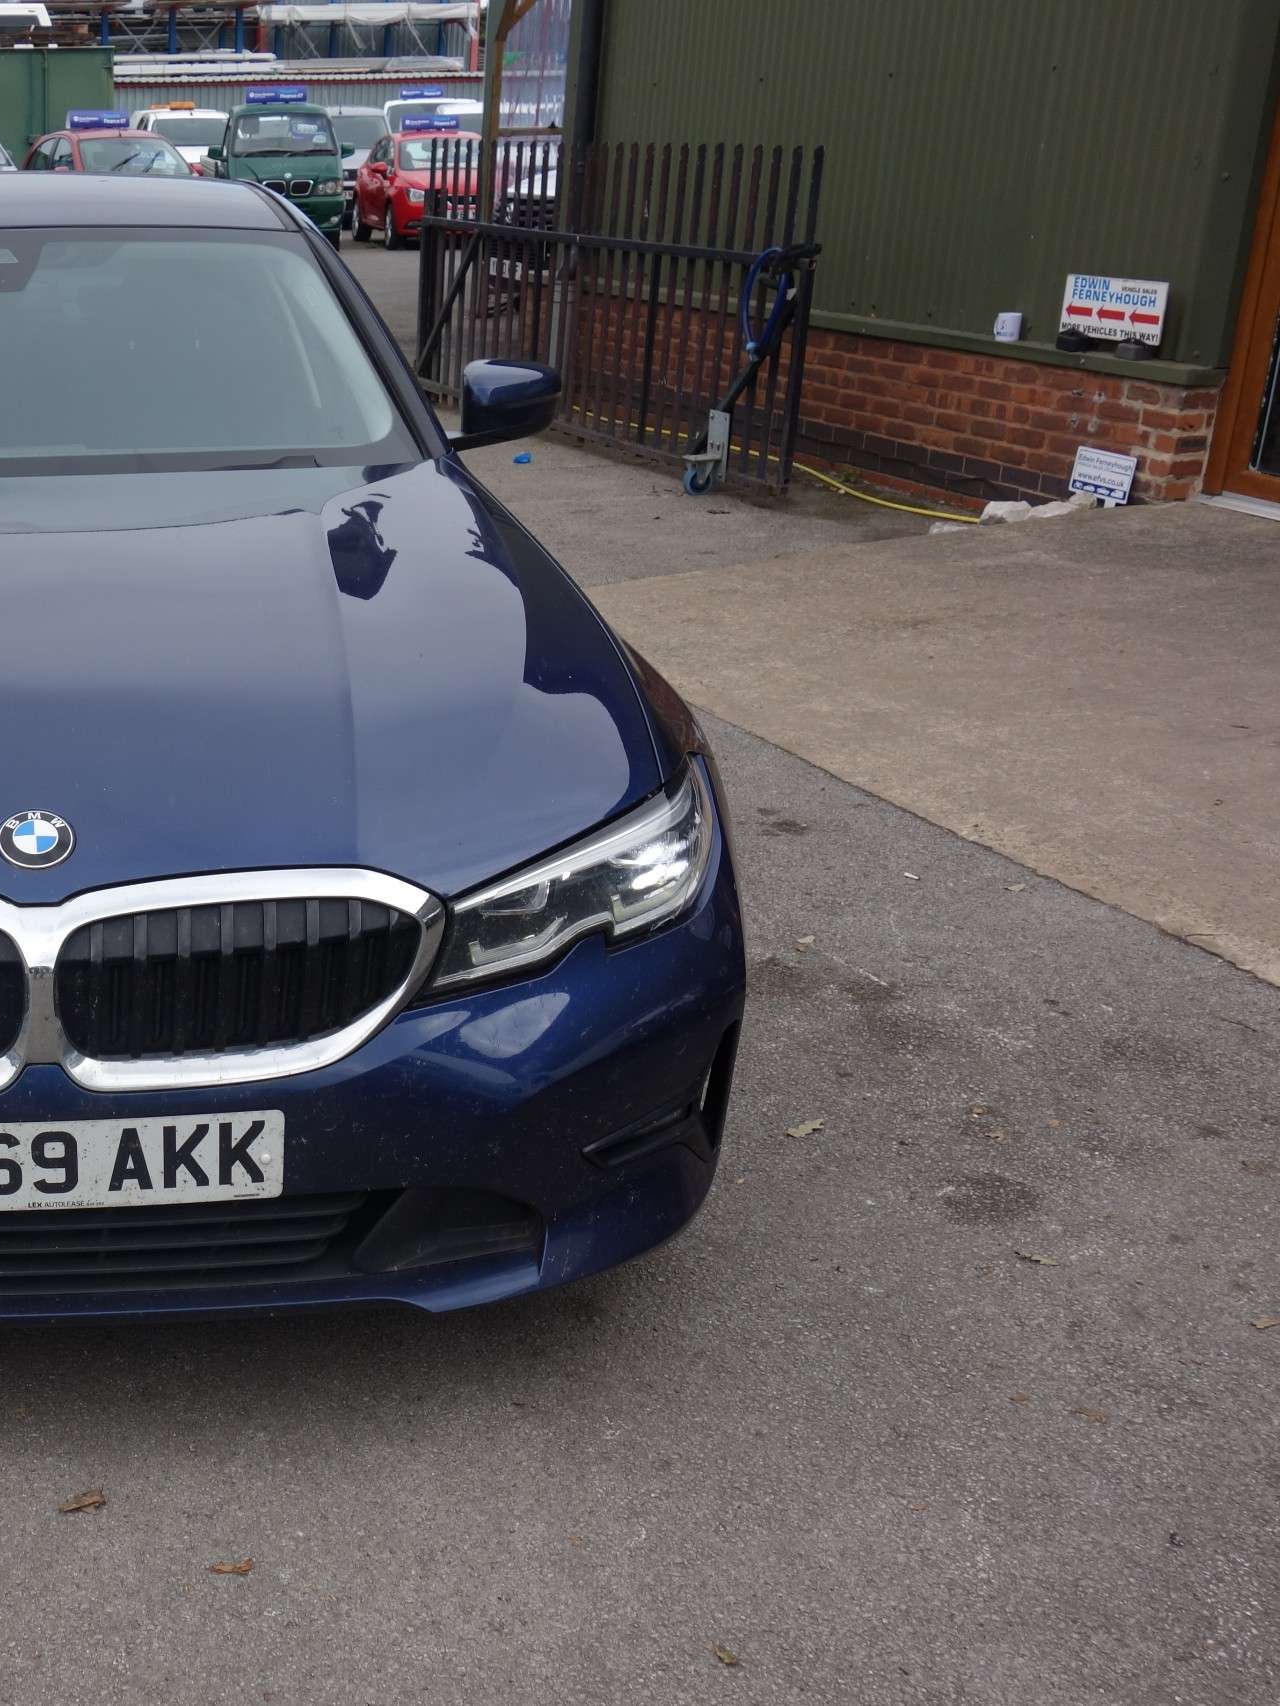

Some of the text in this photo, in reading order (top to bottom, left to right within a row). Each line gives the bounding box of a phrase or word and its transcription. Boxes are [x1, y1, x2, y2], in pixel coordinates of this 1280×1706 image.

[1074, 276, 1110, 290] EDWIN
[1072, 288, 1157, 308] FERNEYHOUGH
[1082, 325, 1118, 337] VEHICLES
[1119, 329, 1137, 339] THIS
[1139, 332, 1159, 342] WAY!
[5, 812, 65, 829] BMW
[109, 1120, 265, 1191] AKK
[45, 1200, 85, 1208] AUTOLEASE
